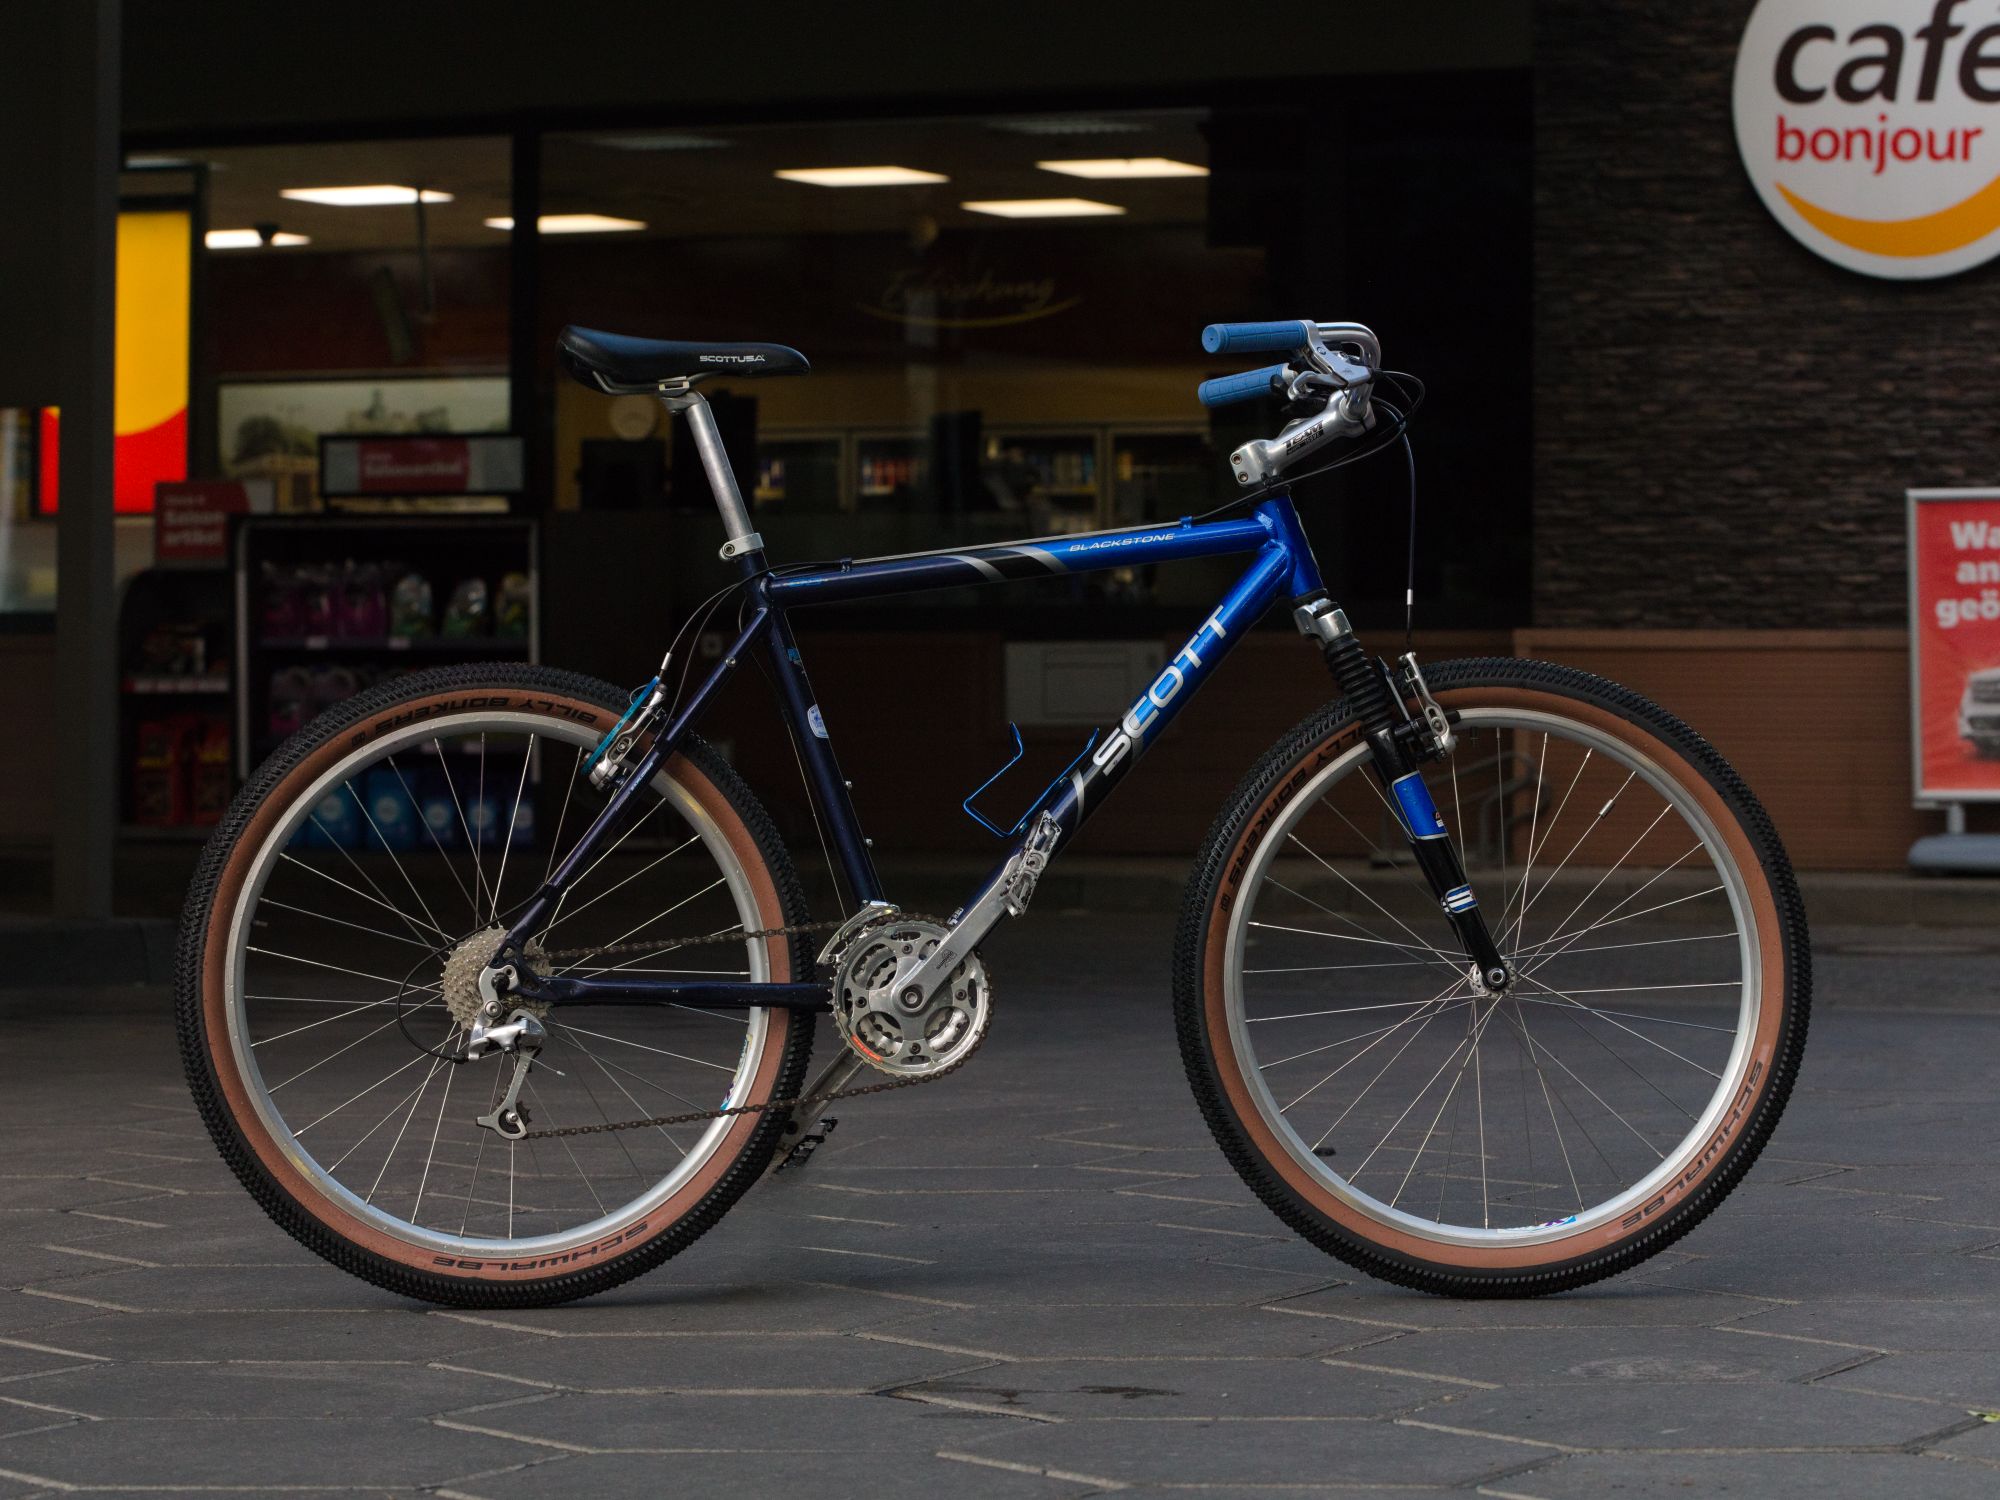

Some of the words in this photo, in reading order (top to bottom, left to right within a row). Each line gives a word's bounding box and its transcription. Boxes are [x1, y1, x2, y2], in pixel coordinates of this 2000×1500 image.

[1776, 114, 1983, 176] bonjour
[1069, 533, 1175, 552] BLACKSTONE
[376, 697, 510, 733] BONKERS
[519, 698, 598, 724] BILLY
[1093, 605, 1227, 777] SCOTT
[1228, 767, 1307, 887] BONKERS
[1622, 1061, 1763, 1230] SCHWALBE
[432, 1221, 648, 1271] SCHWALBE
